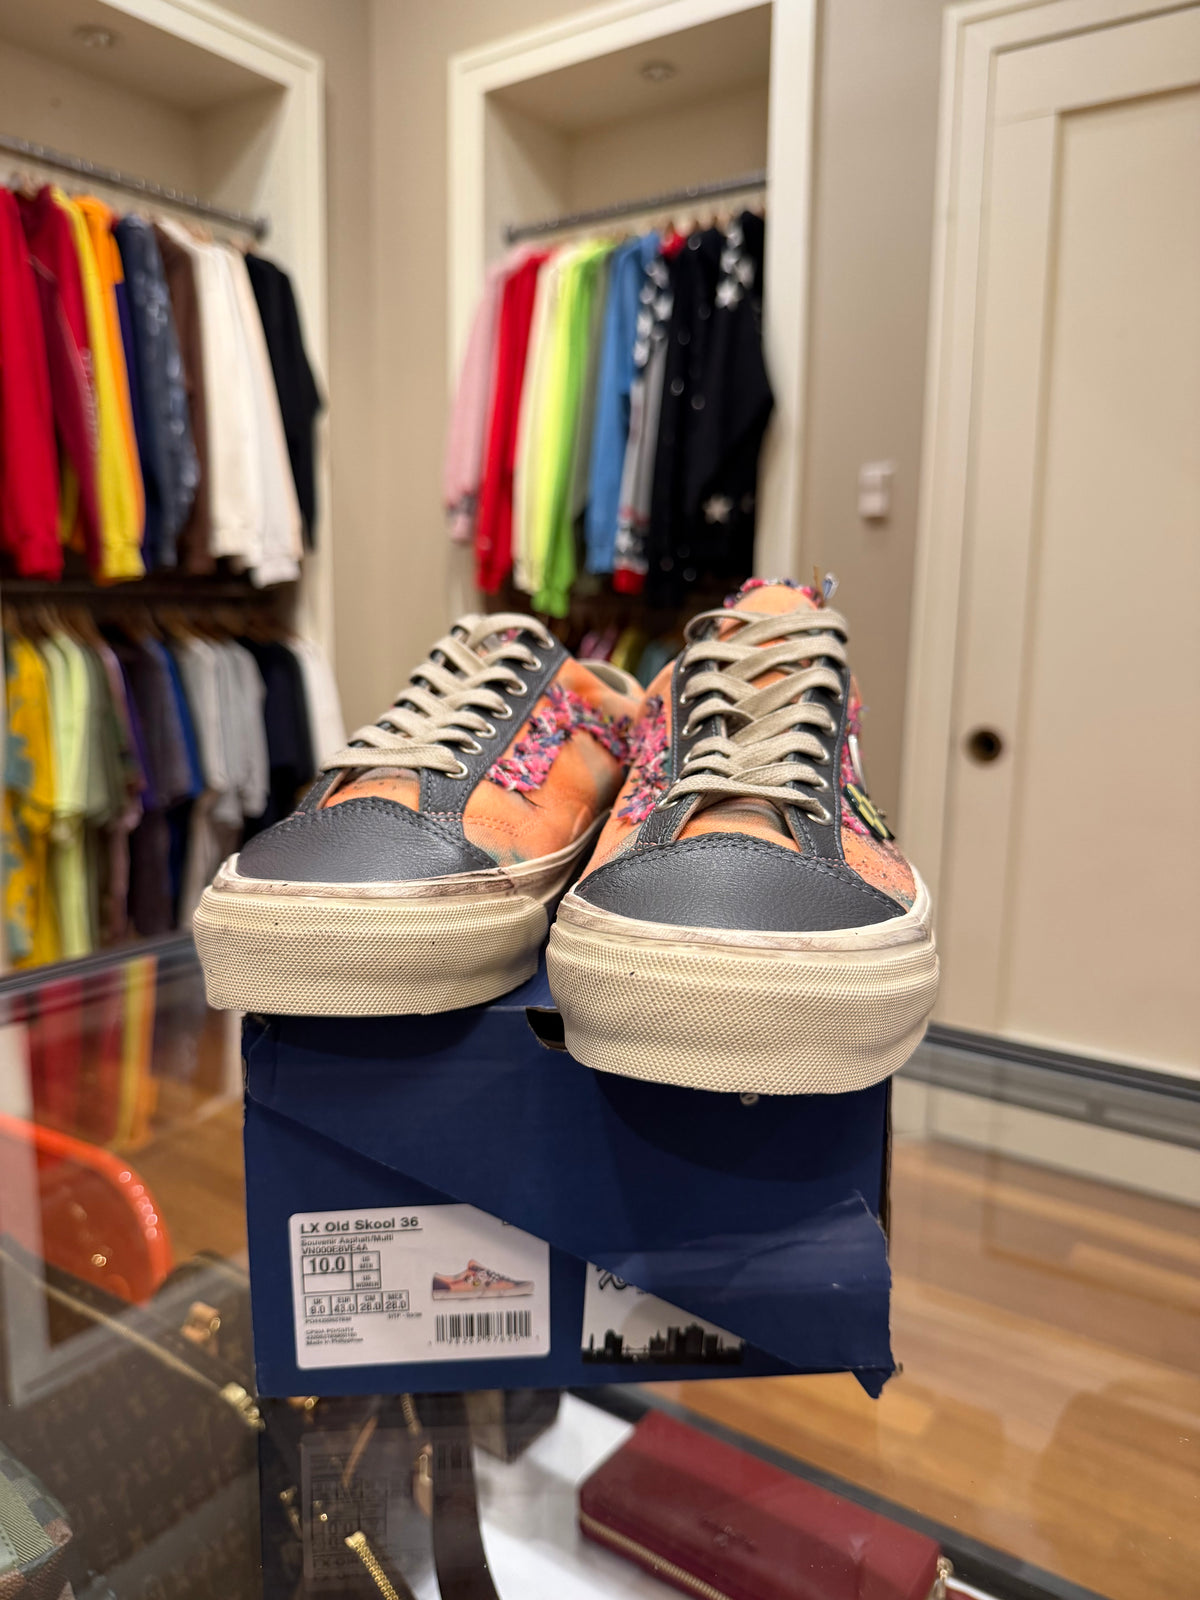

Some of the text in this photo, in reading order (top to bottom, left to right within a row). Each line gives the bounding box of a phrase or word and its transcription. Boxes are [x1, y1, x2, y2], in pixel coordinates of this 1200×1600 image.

[301, 1216, 419, 1234] LX Old Skool 36
[301, 1233, 394, 1246] Souvenir Asphalt/Multi
[309, 1256, 345, 1272] 10.0
